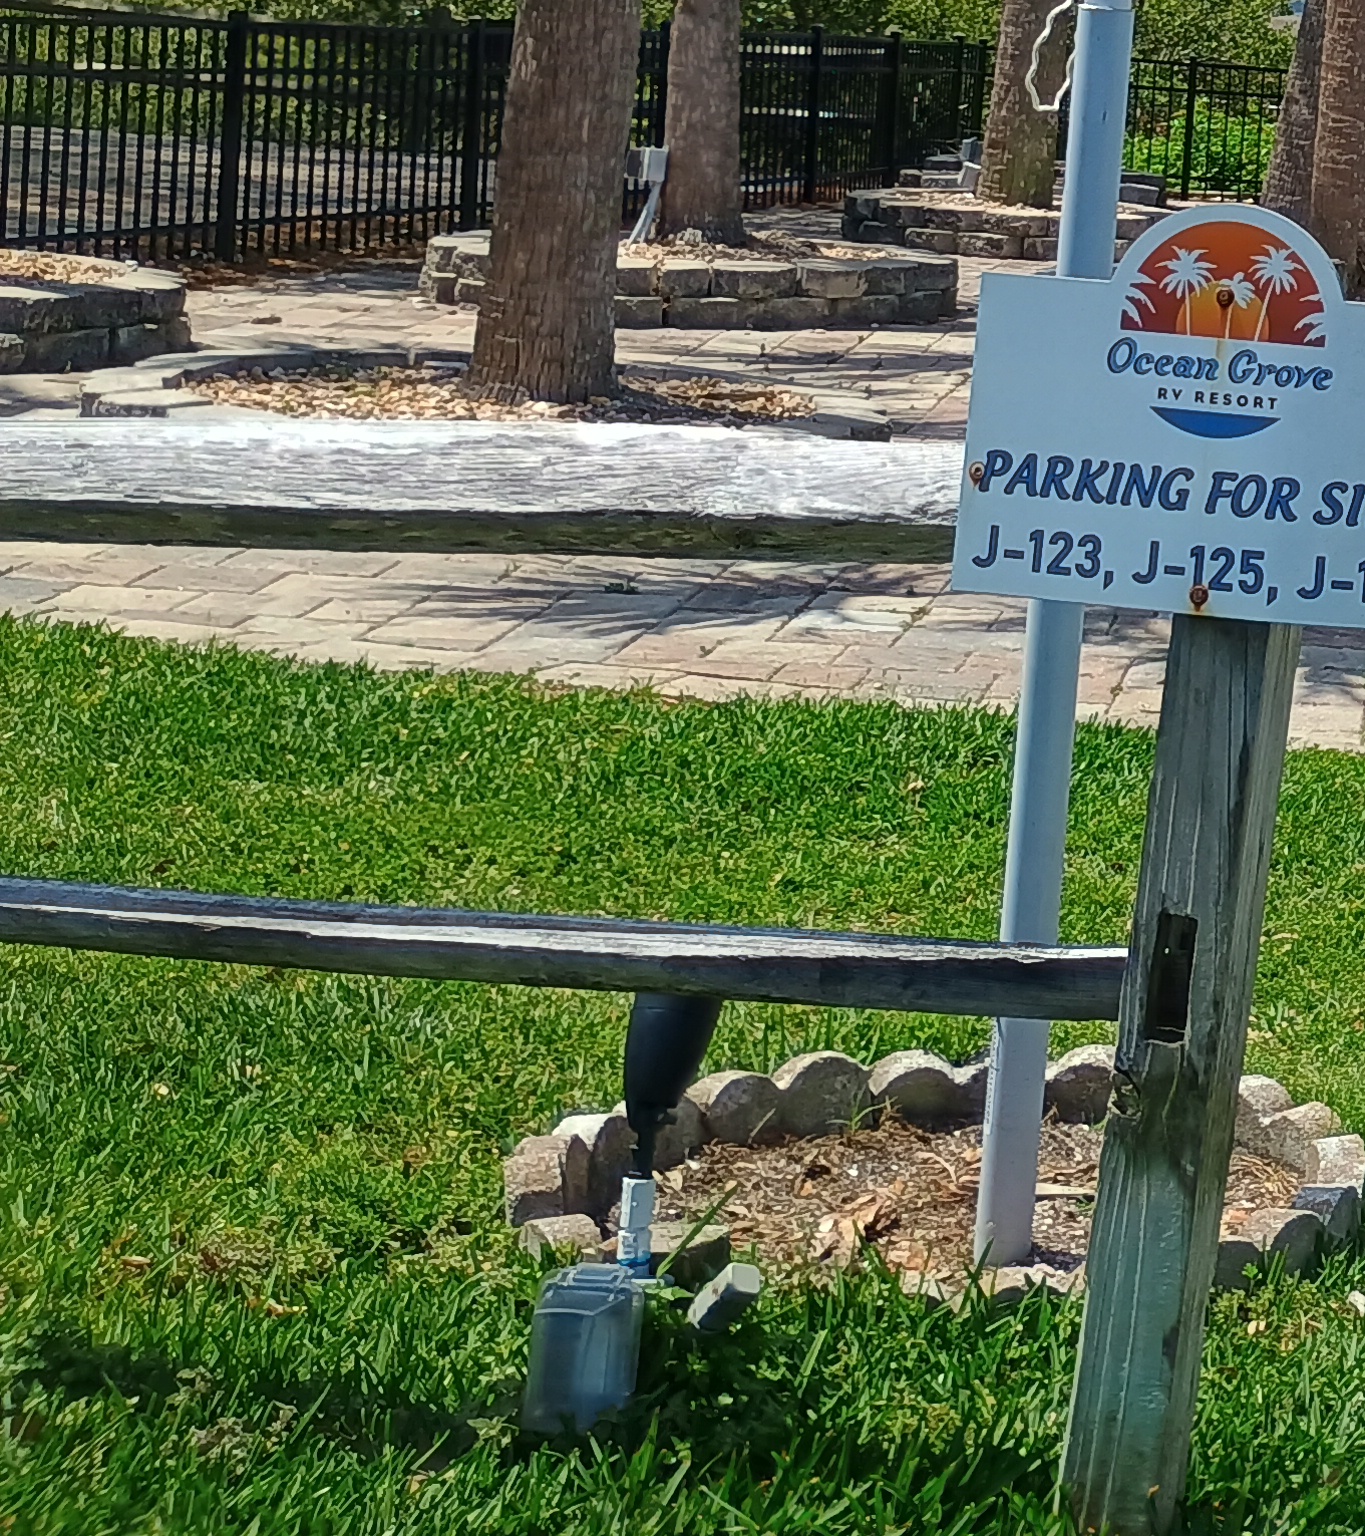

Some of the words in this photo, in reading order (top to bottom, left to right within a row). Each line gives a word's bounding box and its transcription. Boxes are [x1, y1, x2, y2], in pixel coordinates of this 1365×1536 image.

[1106, 336, 1220, 381] Ocean
[1228, 348, 1334, 391] Grove
[1157, 387, 1183, 401] RV
[1194, 390, 1278, 410] RESORT
[978, 449, 1195, 511] PARKING
[1204, 471, 1301, 522] FOR
[971, 524, 1115, 591] J-123,
[1131, 540, 1278, 607] J-125,
